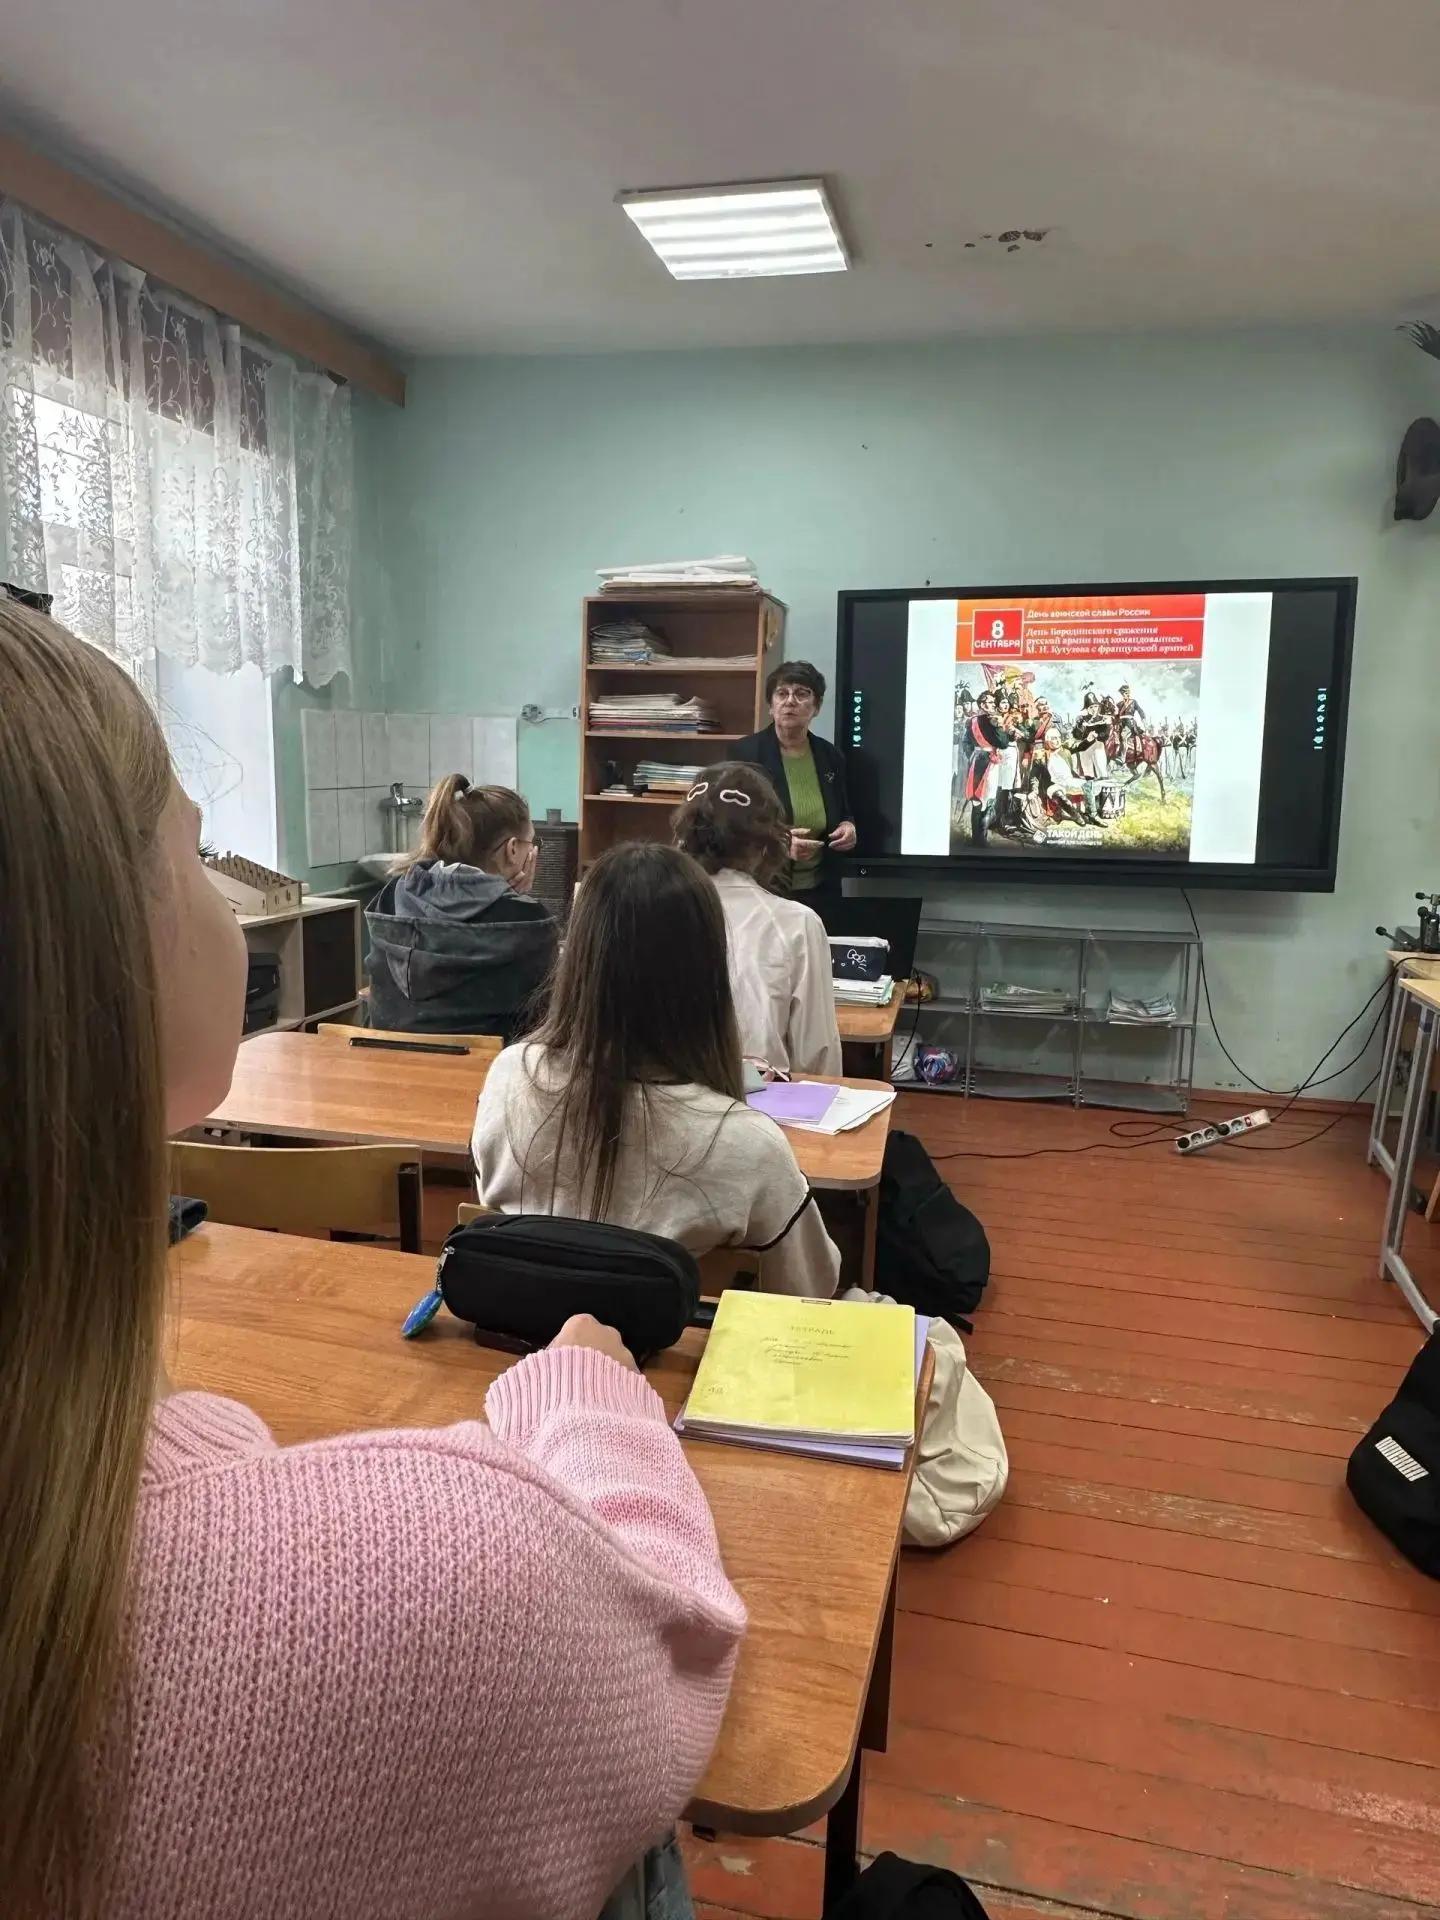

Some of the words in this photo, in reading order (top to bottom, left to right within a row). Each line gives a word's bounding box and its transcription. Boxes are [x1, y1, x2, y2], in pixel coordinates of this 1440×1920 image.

[1027, 609, 1049, 618] День
[1050, 609, 1090, 618] воинской
[1091, 609, 1117, 617] славы
[1119, 608, 1151, 616] России
[991, 619, 1004, 639] 8
[1026, 628, 1048, 637] День
[1050, 627, 1112, 637] Бородинского
[1113, 627, 1158, 636] сражения
[974, 640, 1020, 649] СЕНТЯБРЯ
[1026, 637, 1061, 647] русской
[1110, 636, 1184, 645] командованием
[1051, 646, 1090, 655] Кутузова
[1098, 645, 1157, 655] французской
[1158, 644, 1194, 654] армией
[1046, 829, 1077, 838] ТАКОЙ
